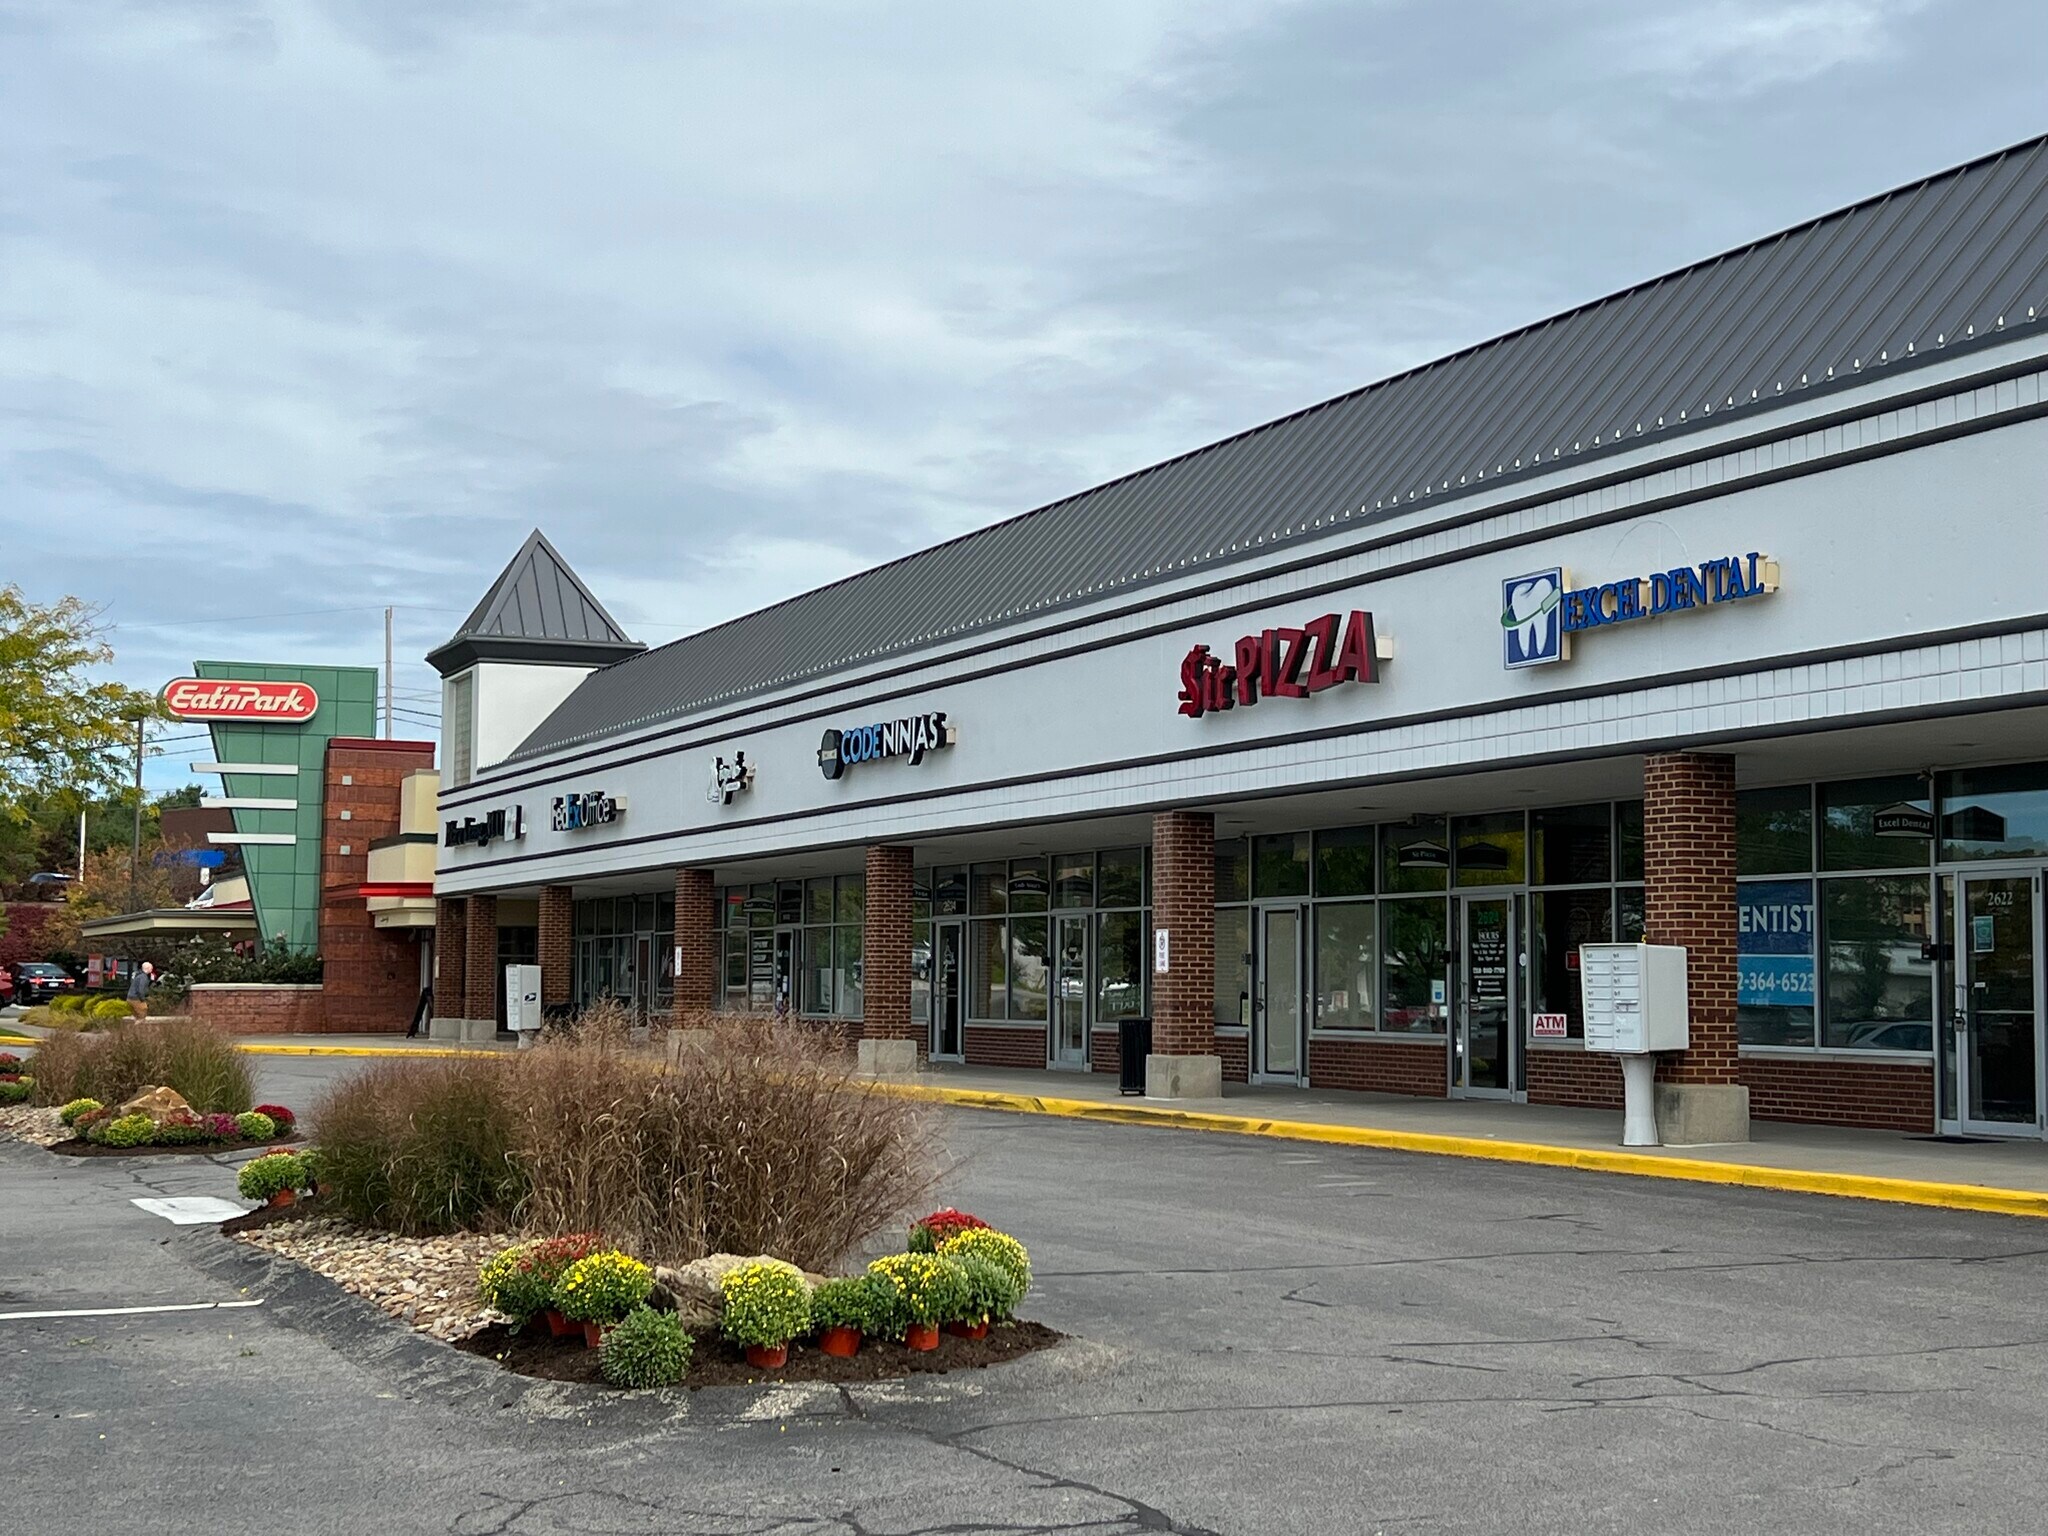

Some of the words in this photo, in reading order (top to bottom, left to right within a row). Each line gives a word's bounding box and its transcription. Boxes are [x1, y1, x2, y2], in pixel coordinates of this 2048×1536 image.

[1562, 577, 1647, 633] EXCEL
[1650, 552, 1765, 615] DENTAL
[1178, 644, 1237, 718] Sir
[1235, 610, 1380, 706] PIZZA
[841, 723, 882, 765] CODE
[882, 711, 941, 765] NINJAS
[1878, 818, 1900, 828] Excel
[1901, 817, 1930, 830] Dental
[1987, 891, 2014, 906] 2622
[1738, 904, 1814, 933] ENTIST
[1737, 971, 1814, 992] 2-364-6523
[1535, 1016, 1565, 1029] ATM
